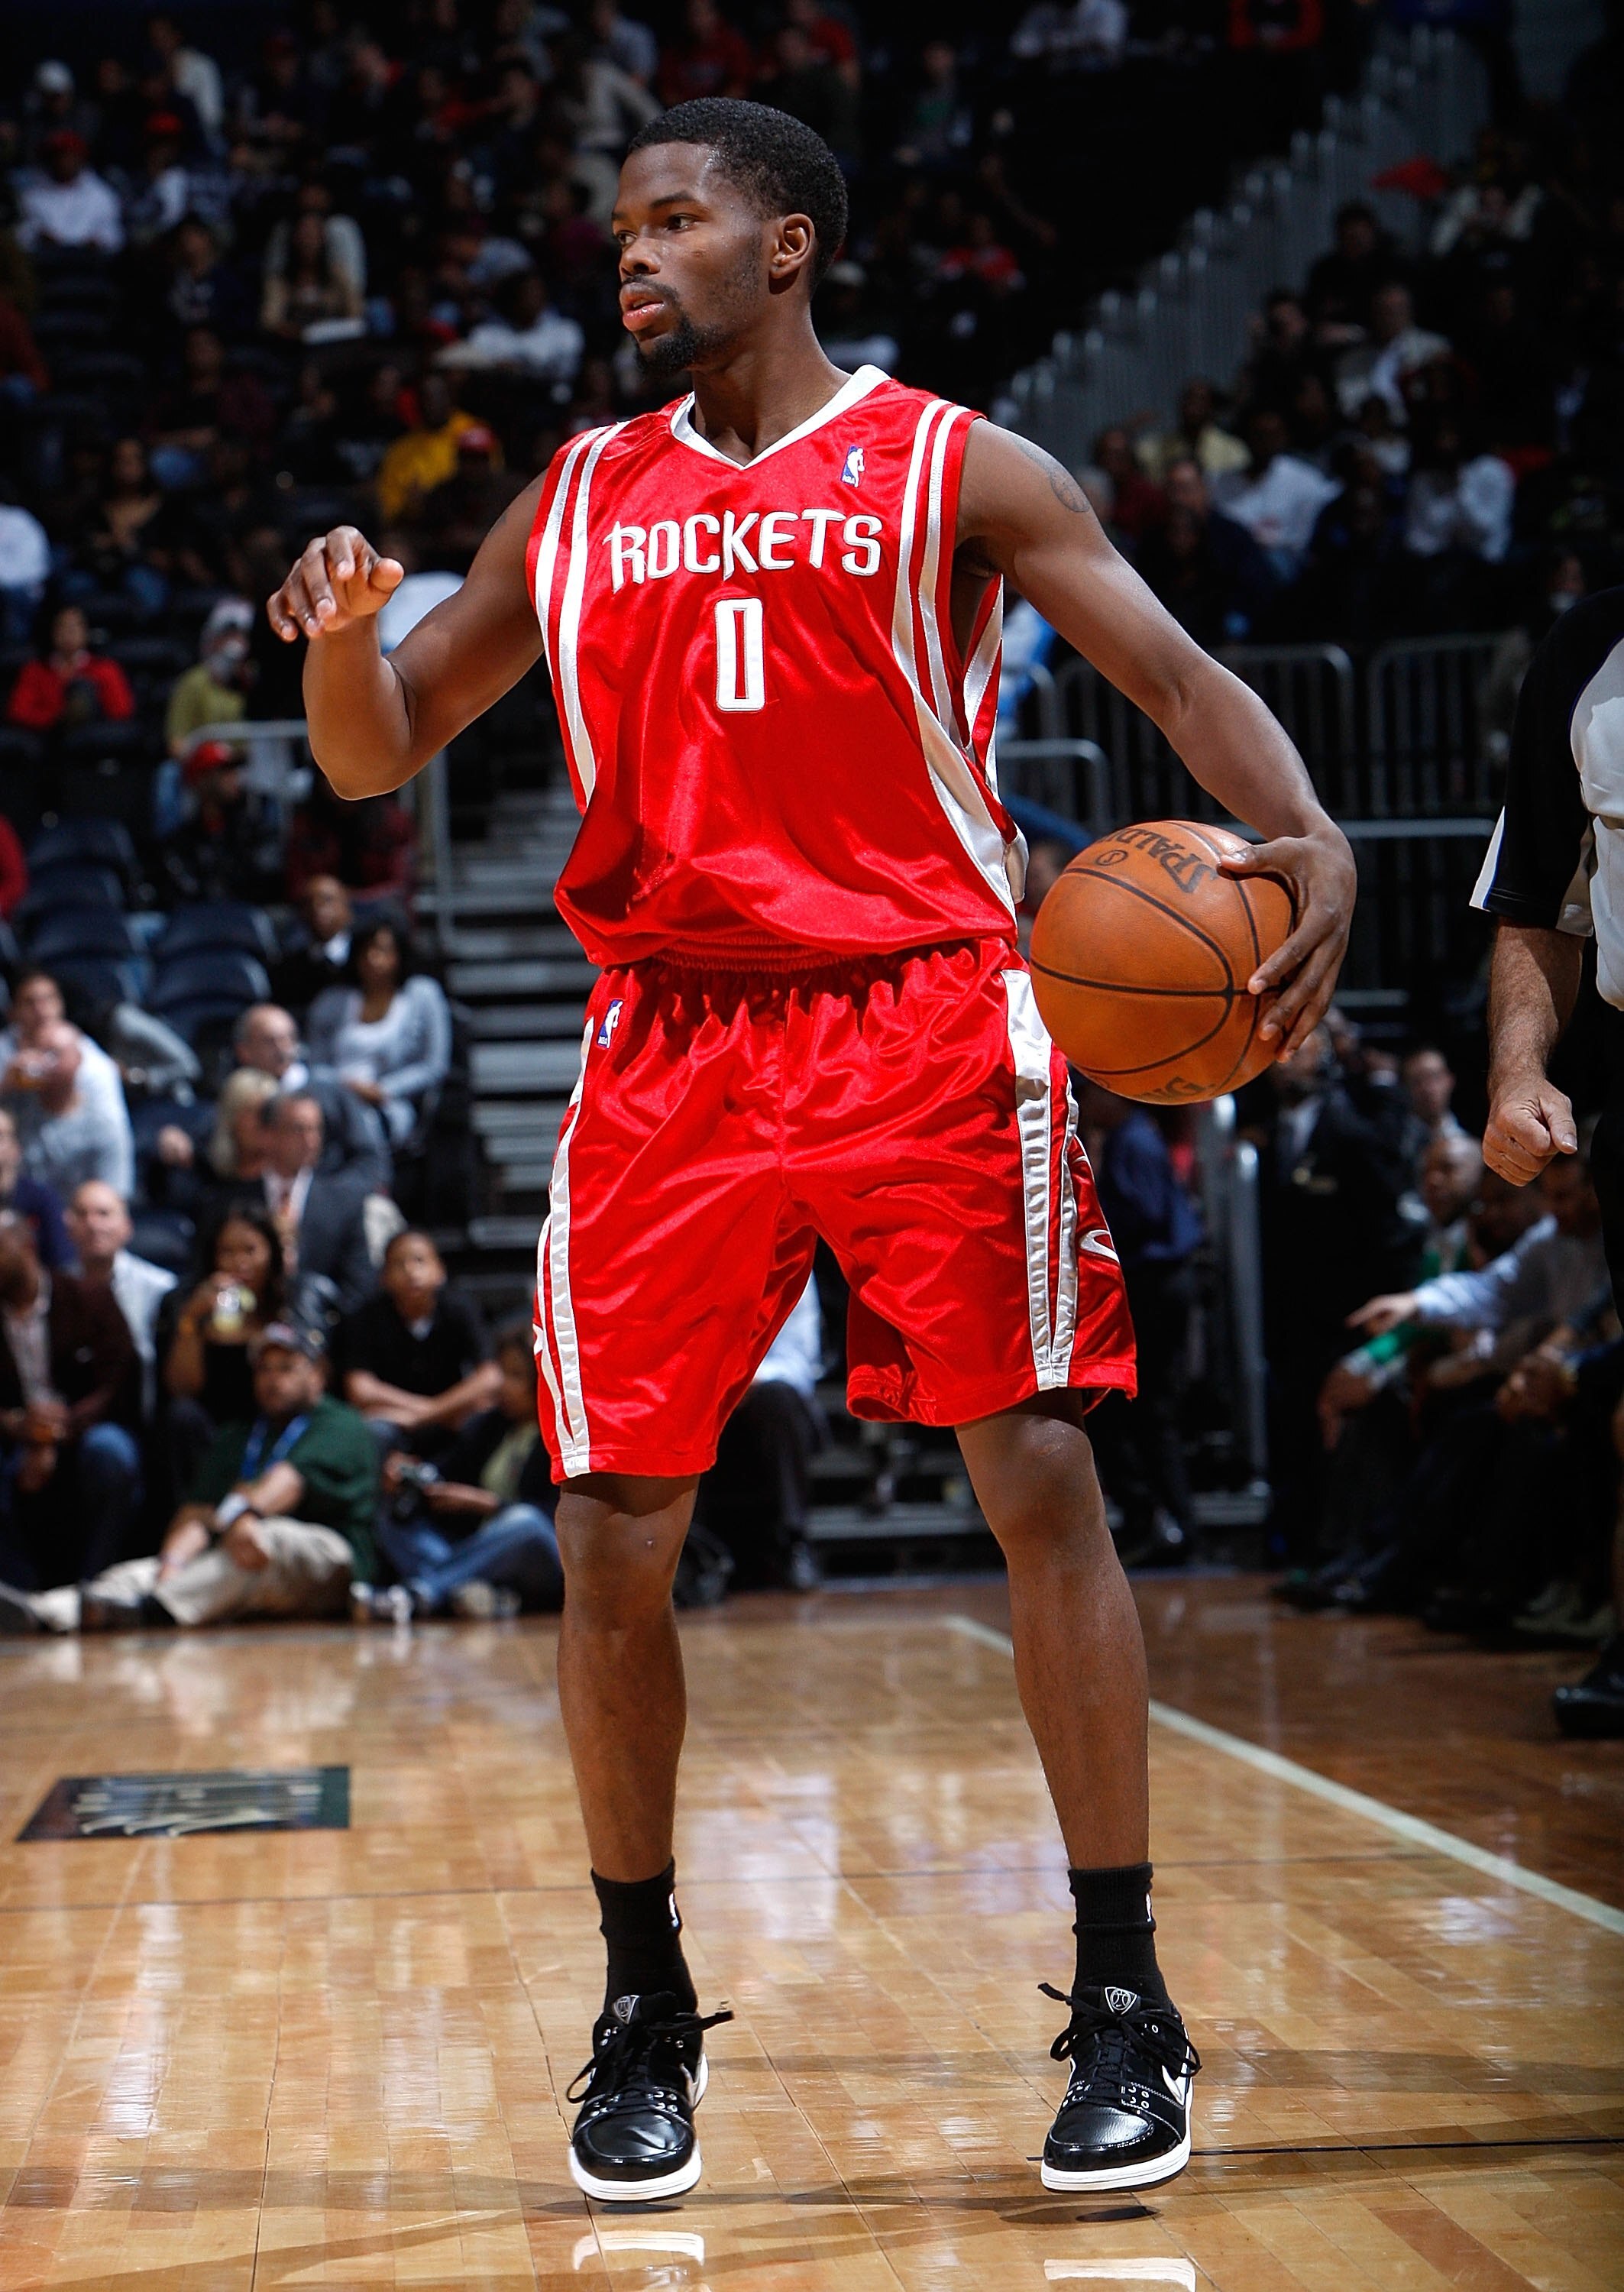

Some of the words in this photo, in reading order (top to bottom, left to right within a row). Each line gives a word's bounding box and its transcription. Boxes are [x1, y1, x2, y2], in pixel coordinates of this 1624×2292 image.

[602, 508, 882, 594] ROCKETS
[715, 597, 765, 712] 0
[1100, 828, 1218, 893] SPALD
